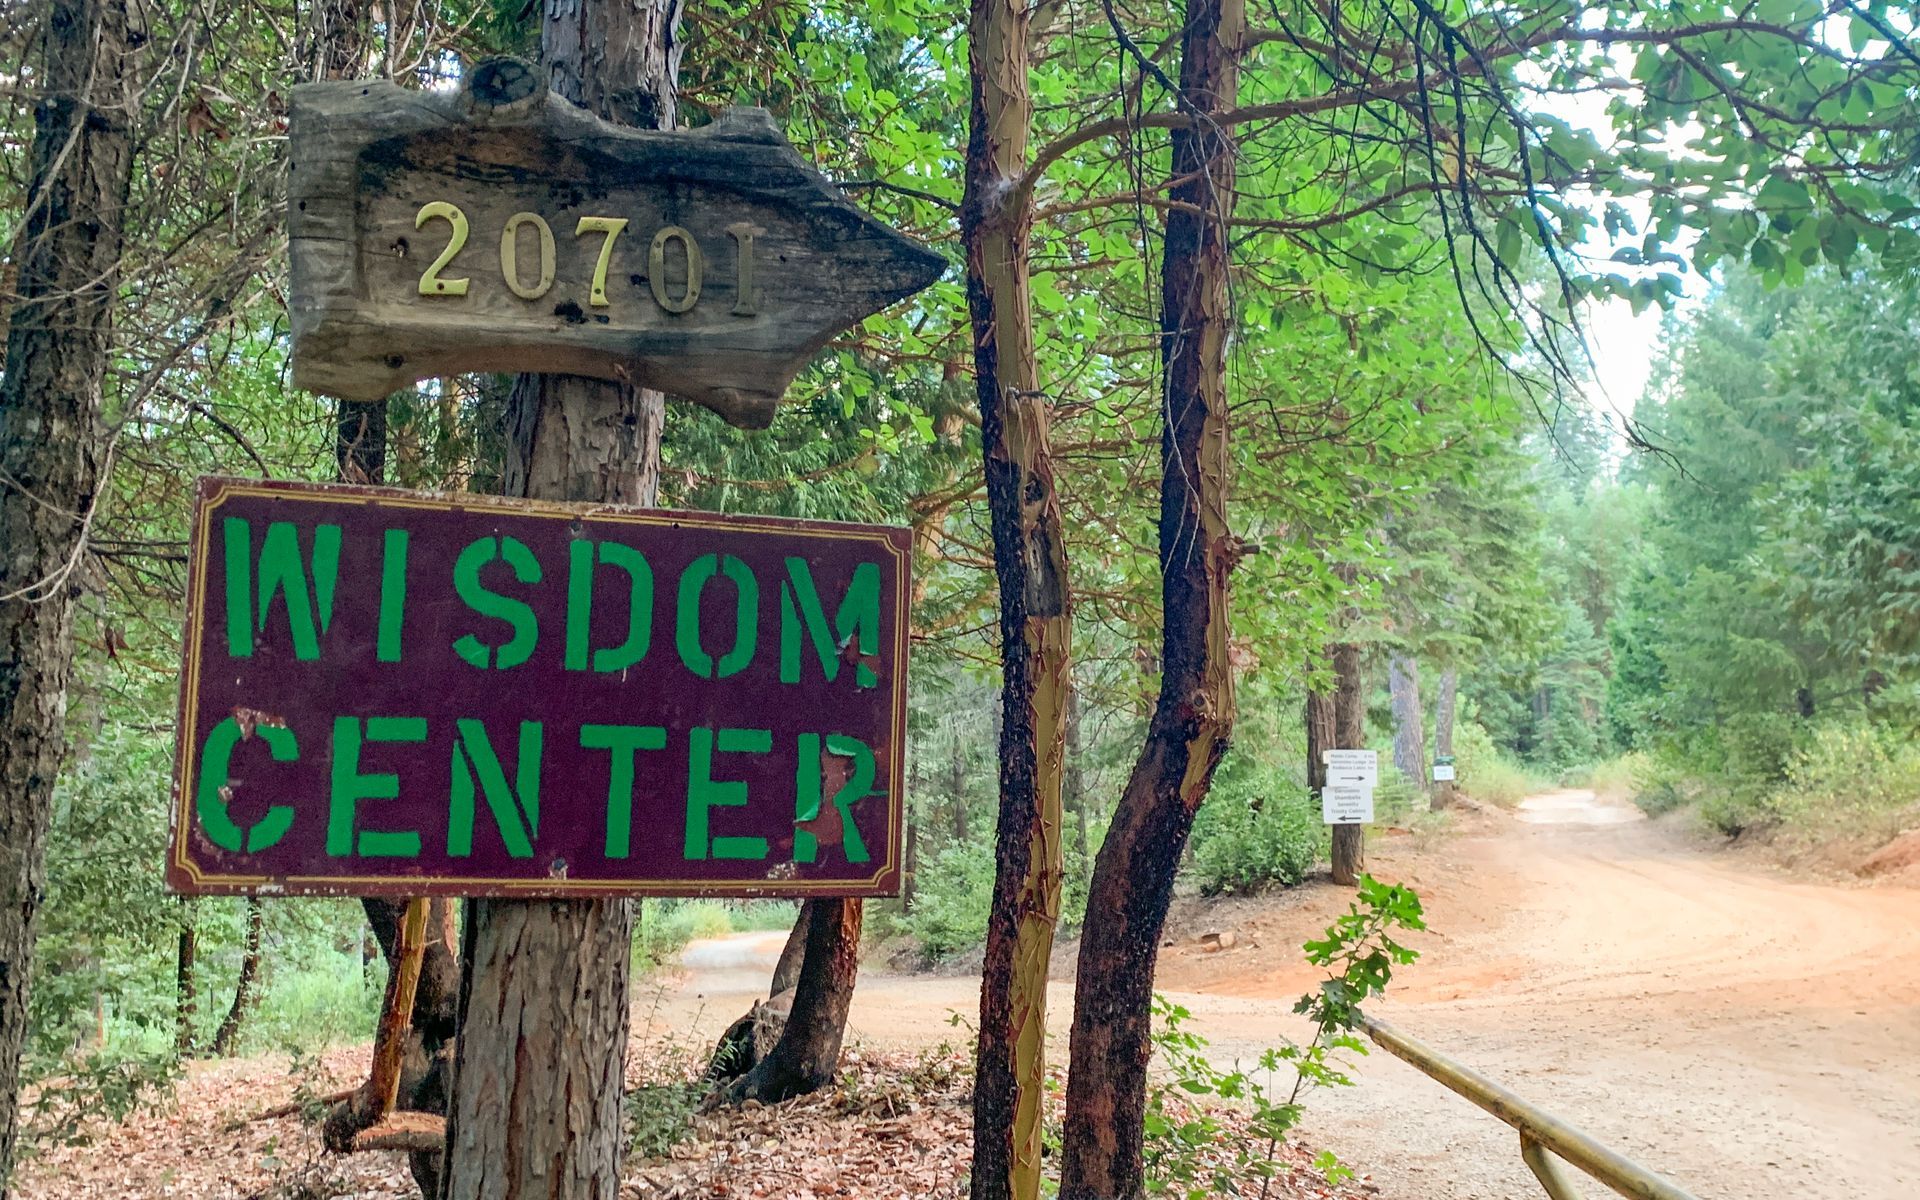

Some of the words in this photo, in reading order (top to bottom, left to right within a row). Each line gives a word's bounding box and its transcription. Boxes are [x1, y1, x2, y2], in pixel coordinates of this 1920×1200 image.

[414, 201, 766, 317] 20701
[223, 517, 881, 689] WISDOM
[198, 715, 878, 864] CENTER
